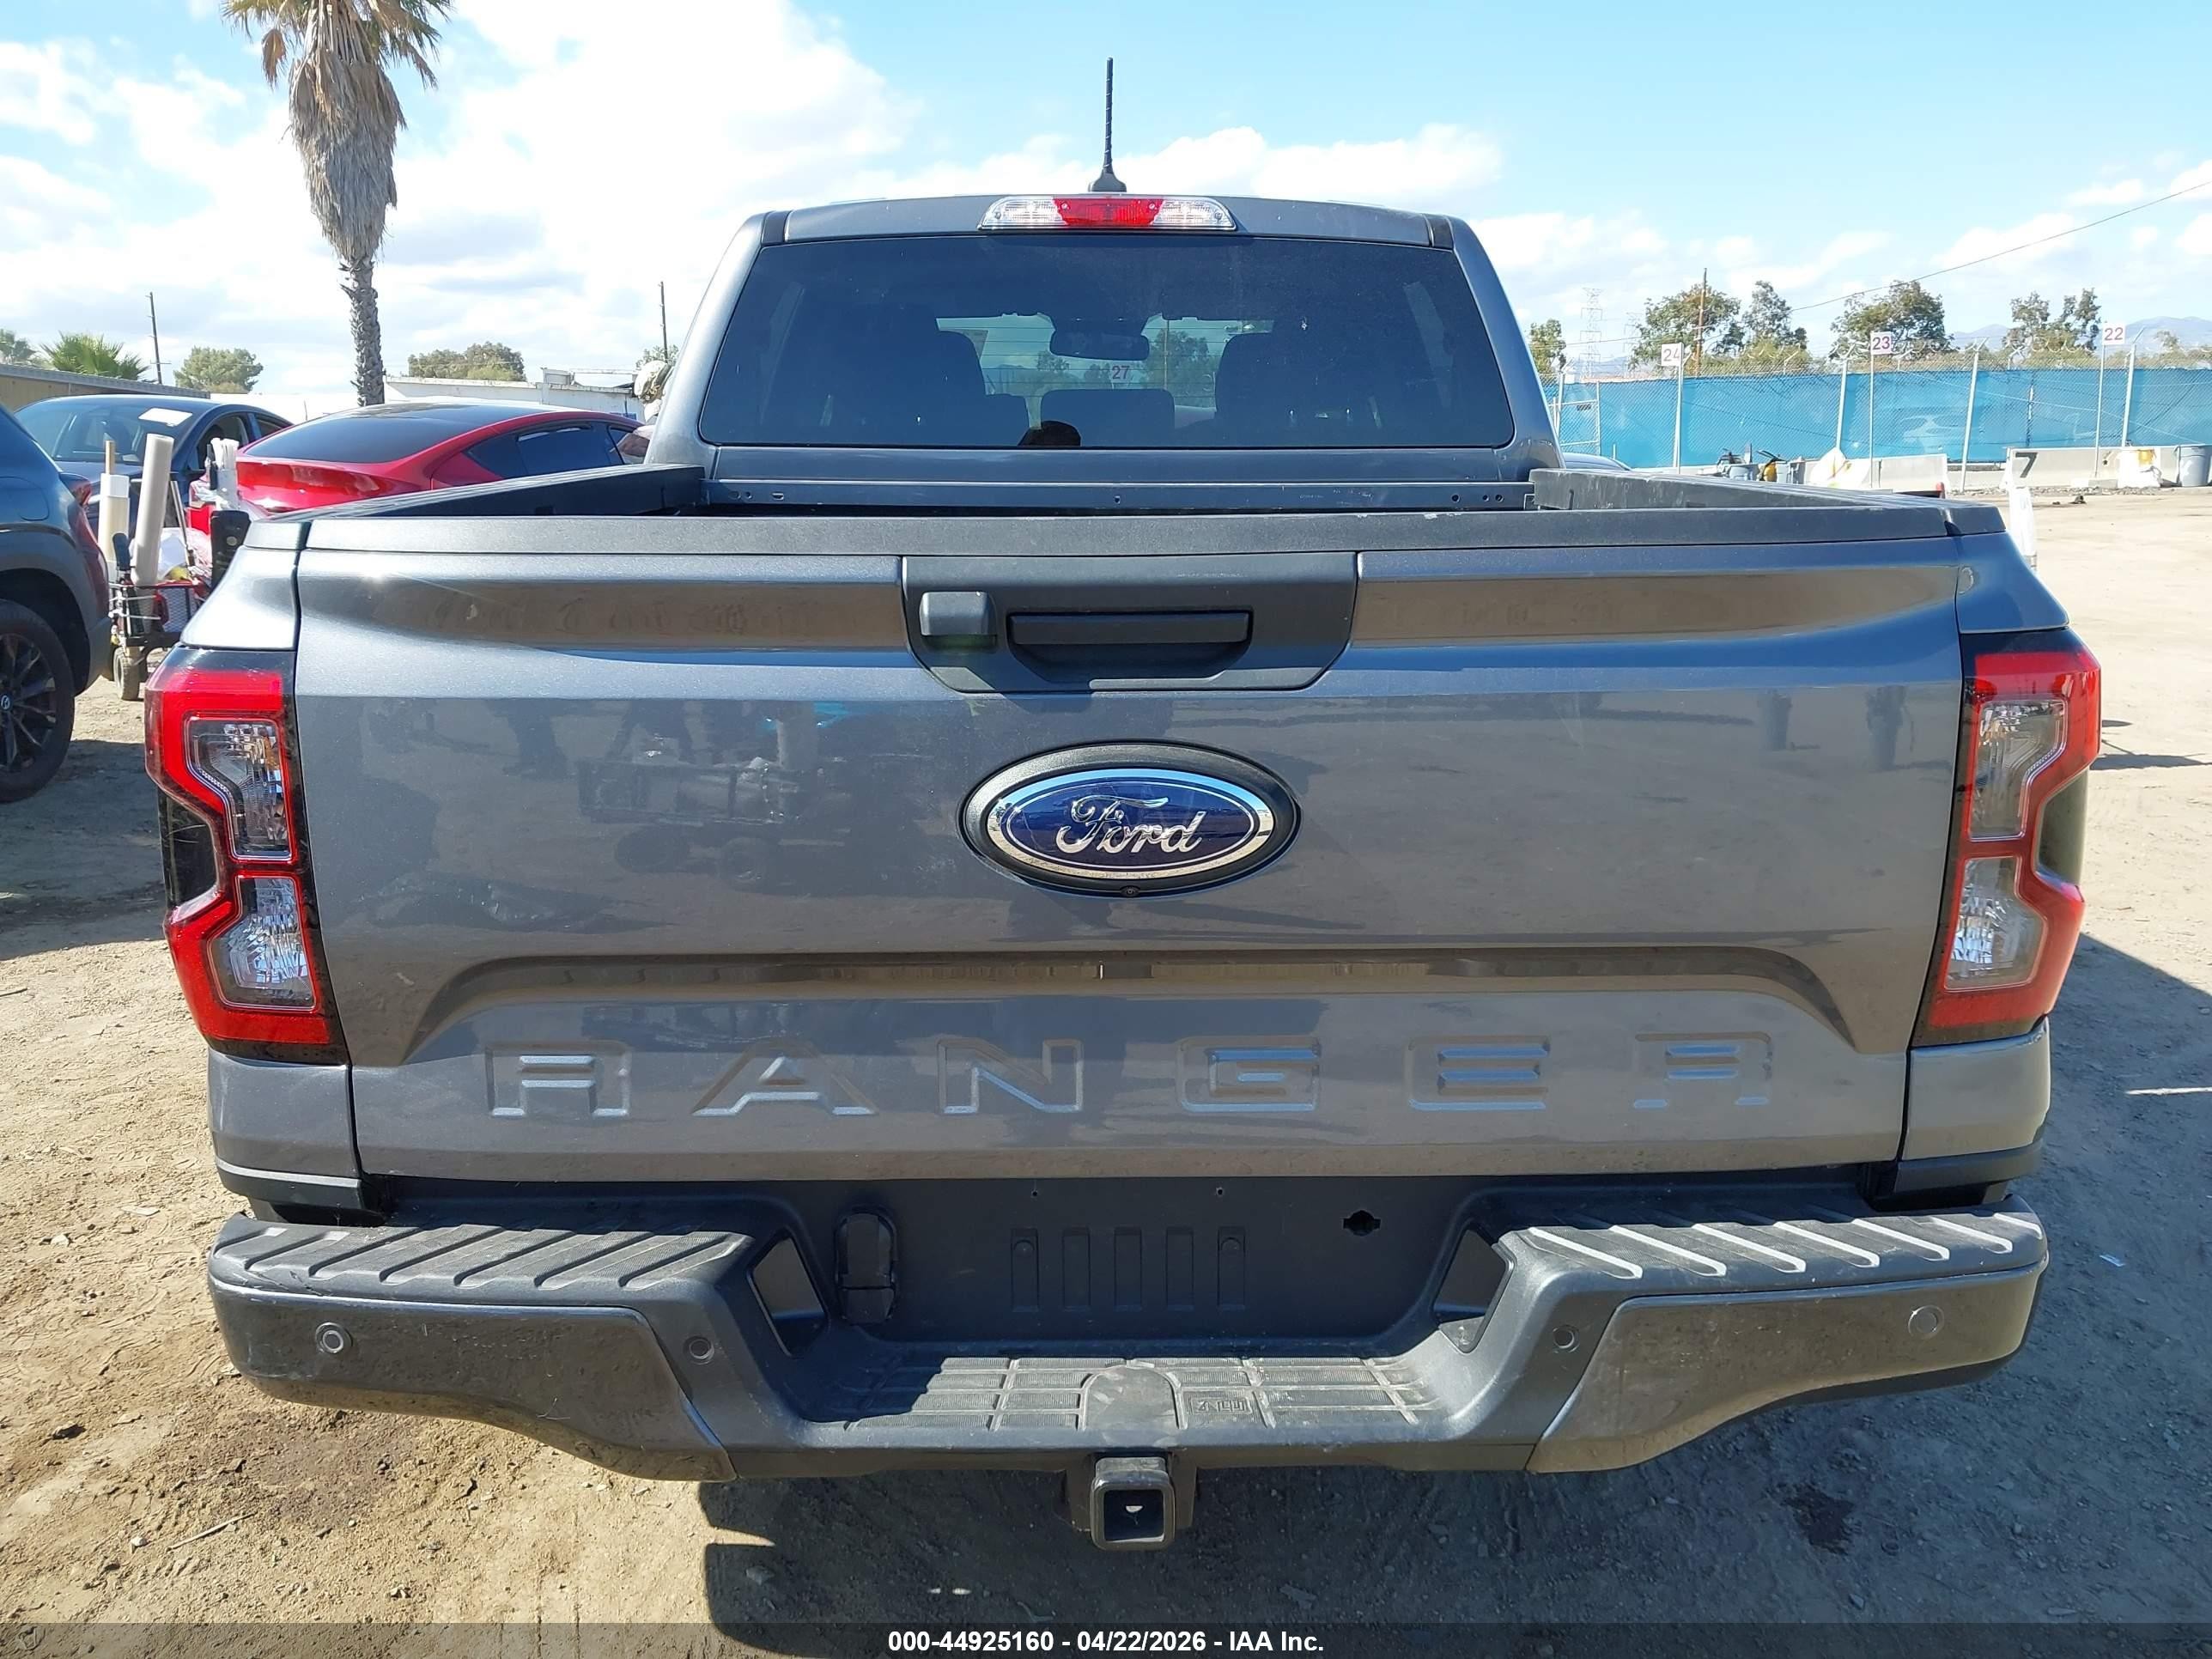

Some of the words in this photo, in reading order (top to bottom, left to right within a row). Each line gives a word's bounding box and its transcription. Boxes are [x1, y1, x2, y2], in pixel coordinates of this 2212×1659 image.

[2104, 327, 2124, 341] 22
[1872, 336, 1891, 350] 23
[1663, 347, 1681, 362] 24
[1112, 365, 1130, 380] 27
[2014, 452, 2039, 478] 7
[1055, 793, 1204, 854] Ford
[484, 1031, 1773, 1117] RANGER
